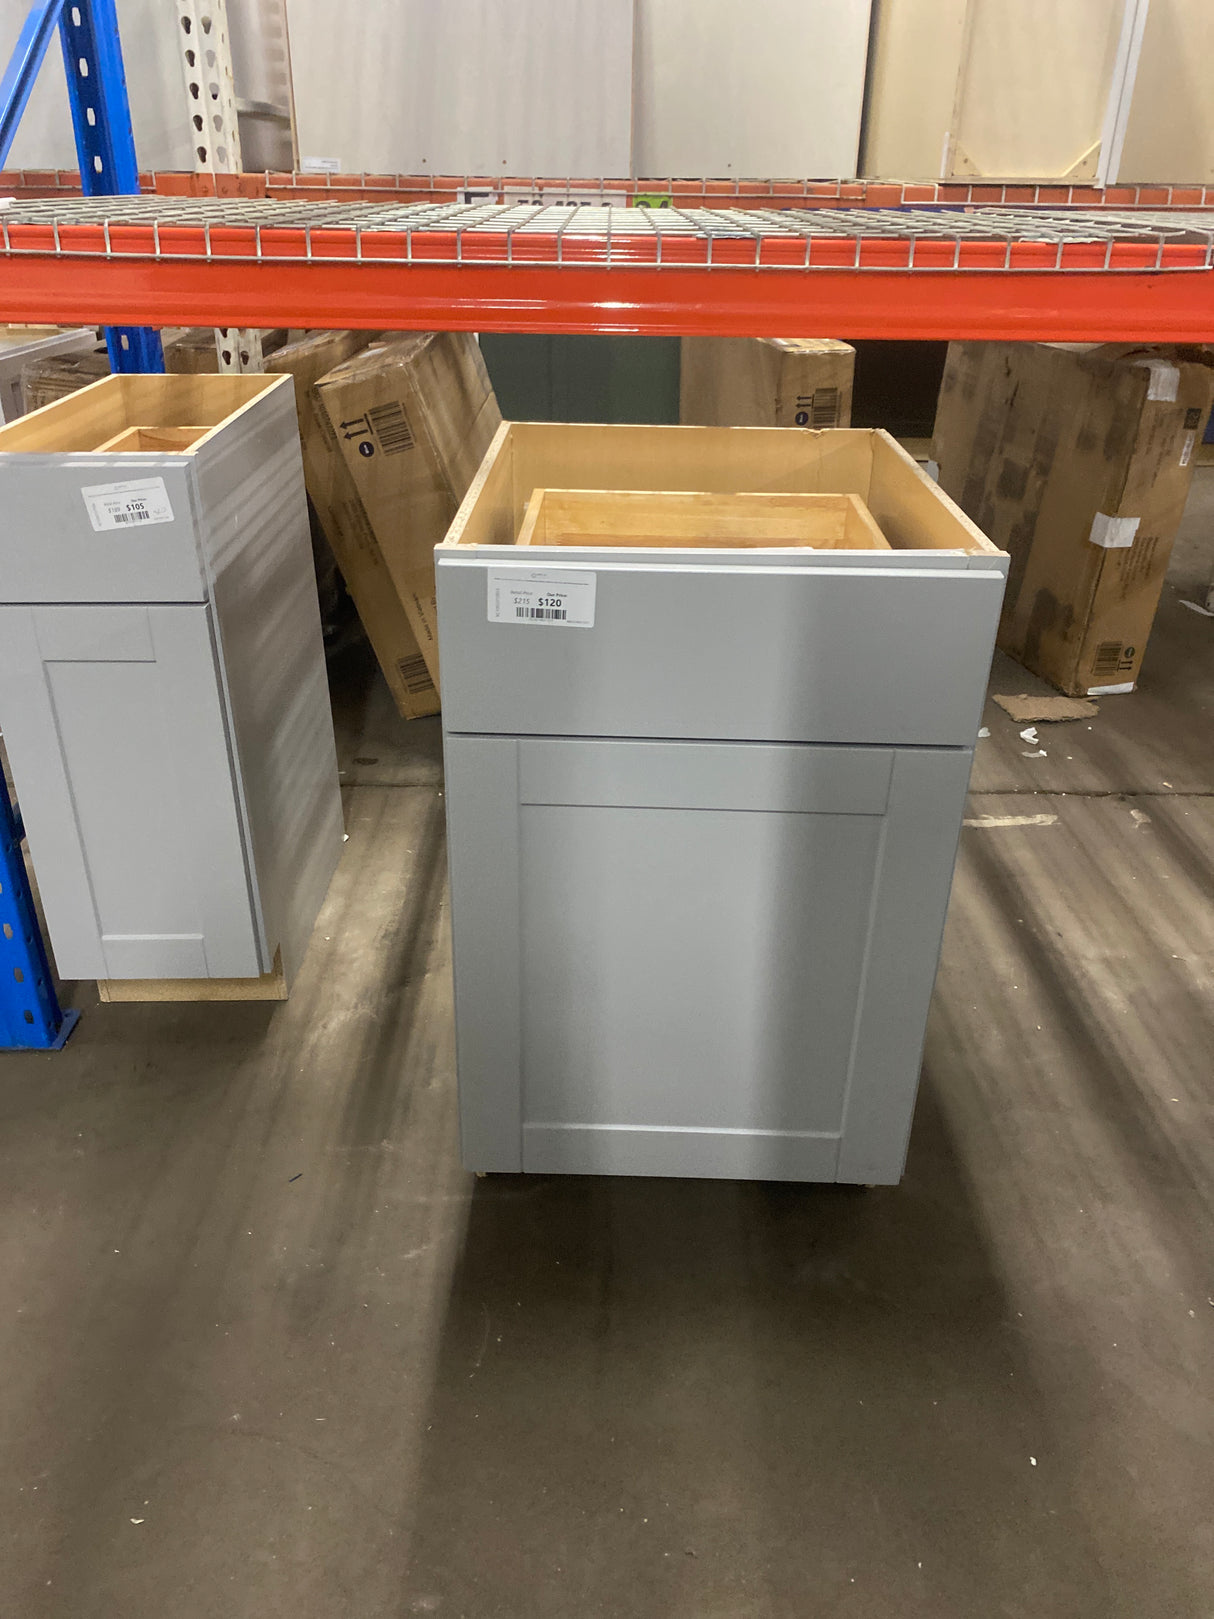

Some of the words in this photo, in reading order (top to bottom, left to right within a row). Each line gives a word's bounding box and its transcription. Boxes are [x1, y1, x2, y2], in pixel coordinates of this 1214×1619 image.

[126, 503, 144, 511] $105
[513, 597, 531, 605] $215
[538, 597, 562, 607] $120
